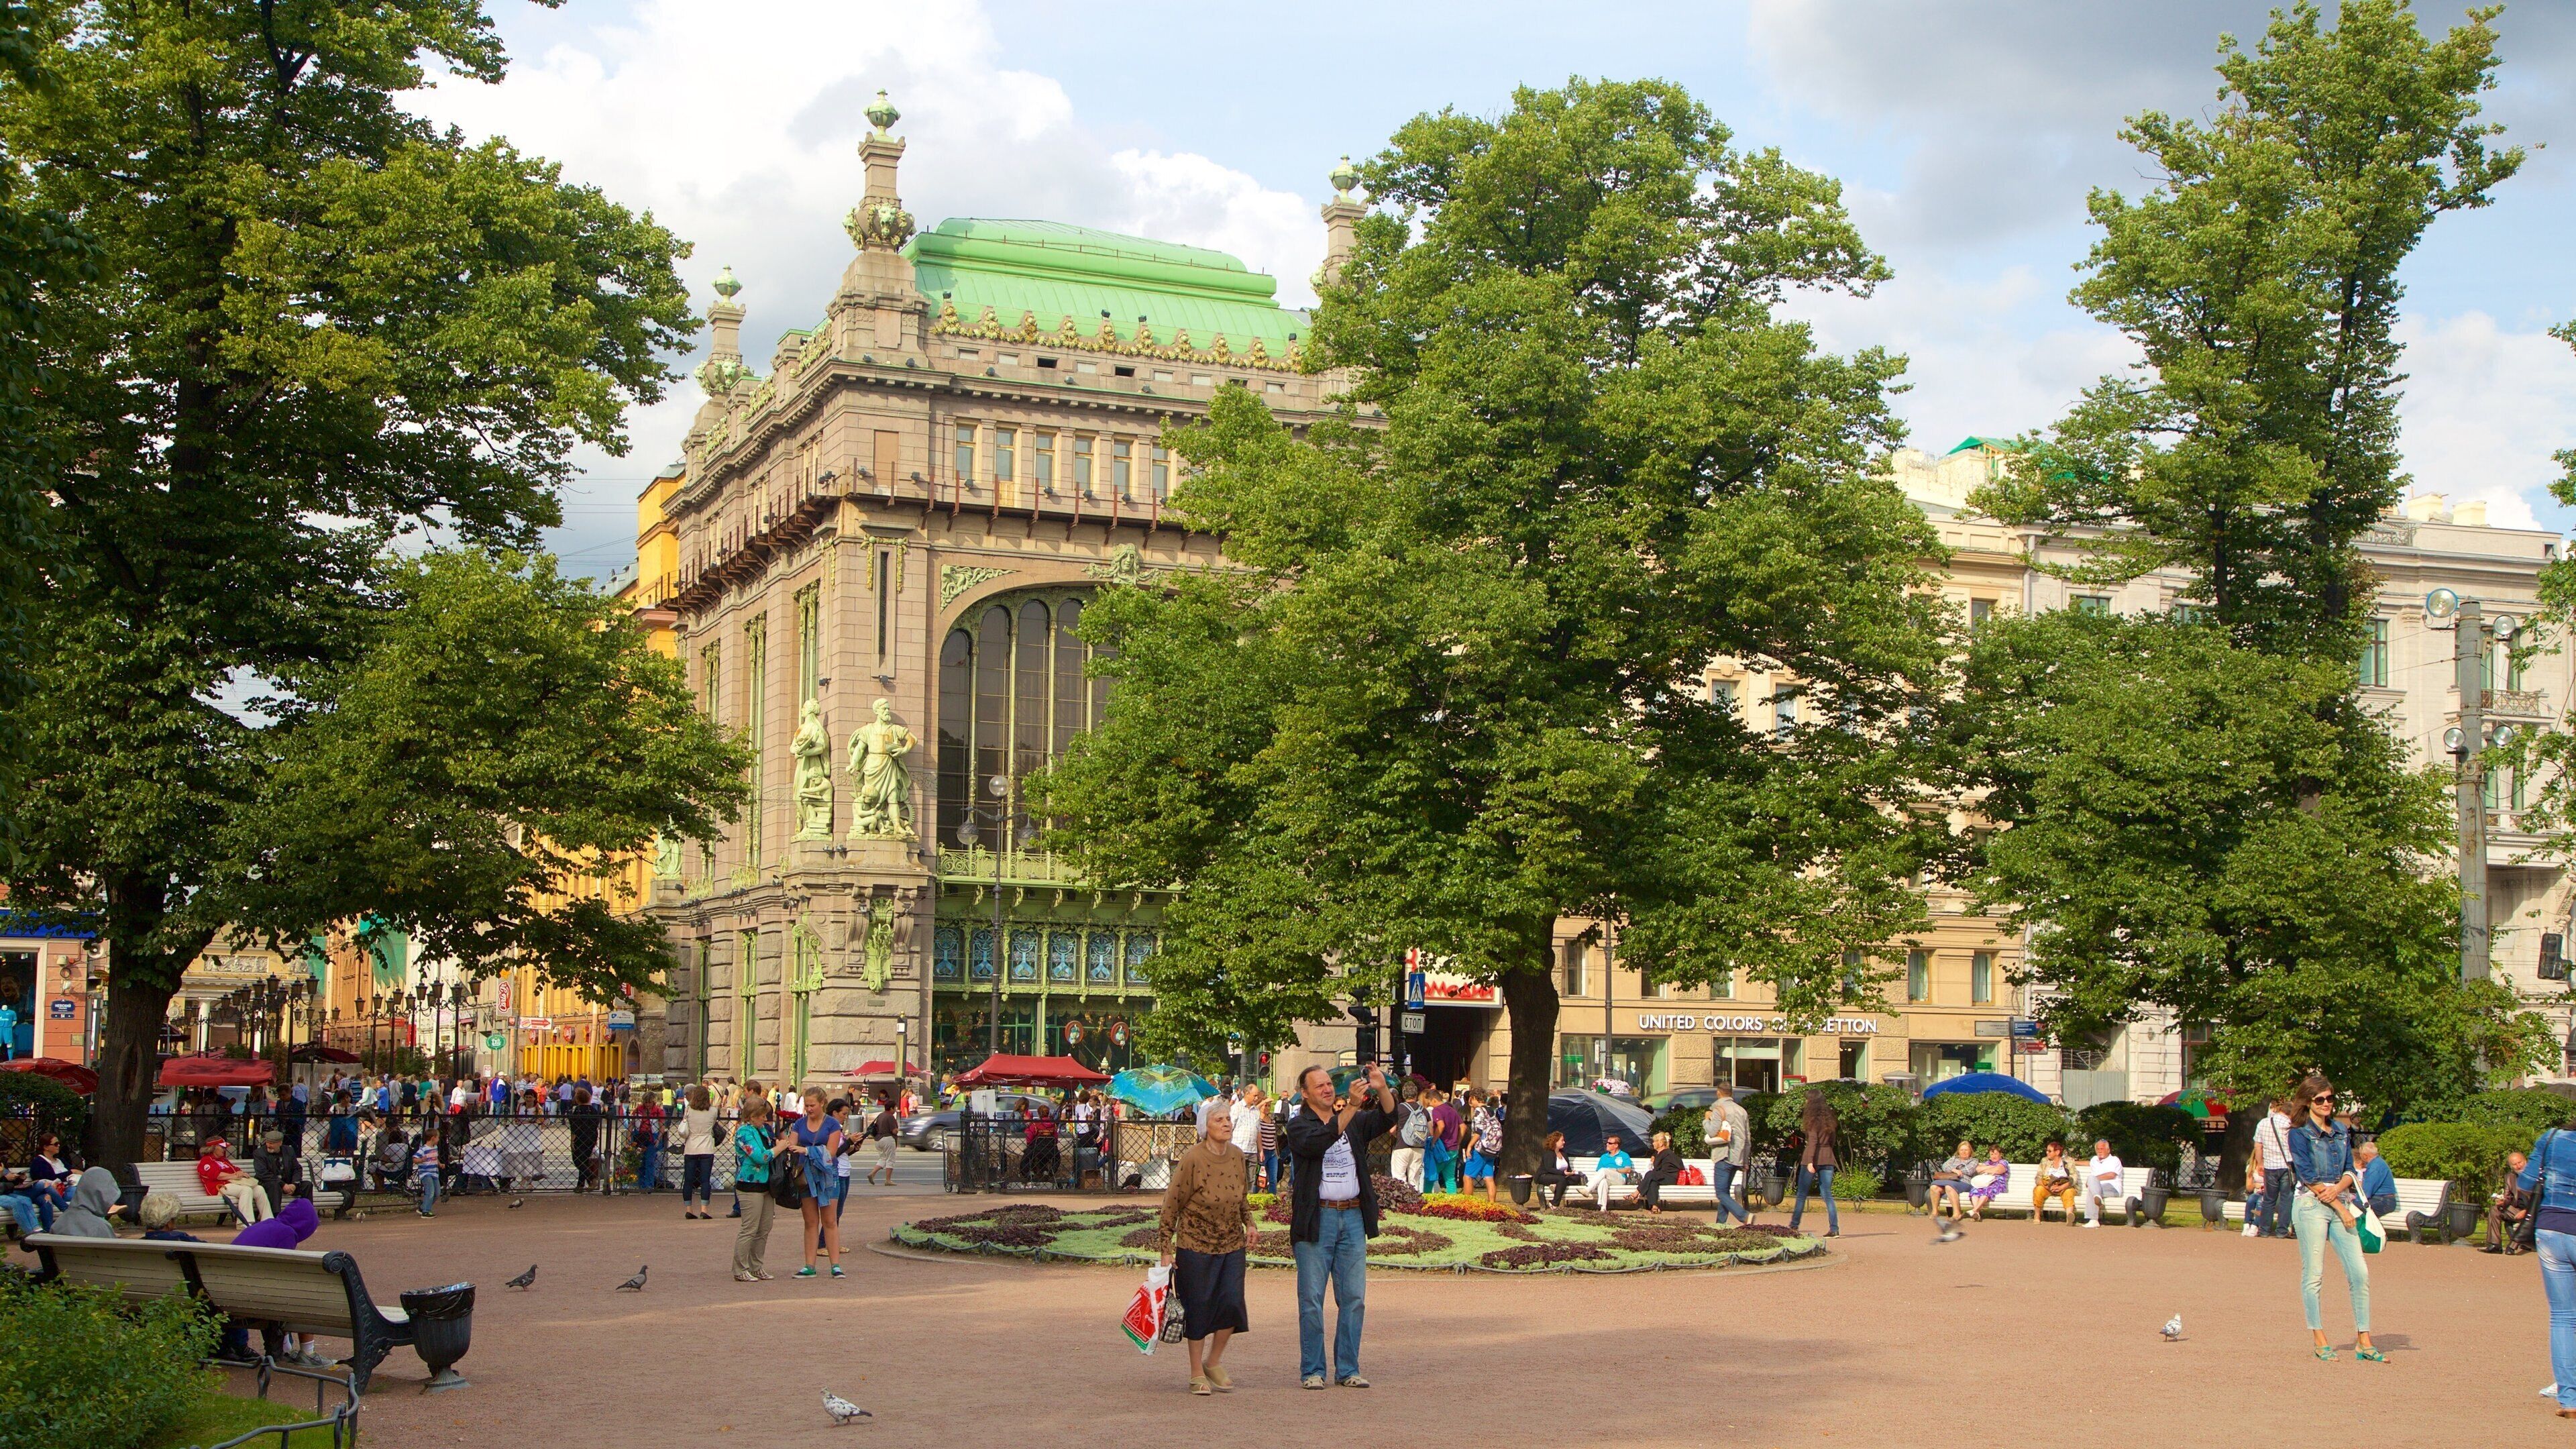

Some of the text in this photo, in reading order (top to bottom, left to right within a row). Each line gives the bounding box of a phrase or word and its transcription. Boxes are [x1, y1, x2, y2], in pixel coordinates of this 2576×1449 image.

[1405, 1018, 1421, 1029] СТОП
[1639, 1014, 1695, 1030] UNITED
[1704, 1016, 1763, 1031] COLORS
[1772, 1017, 1788, 1032] O
